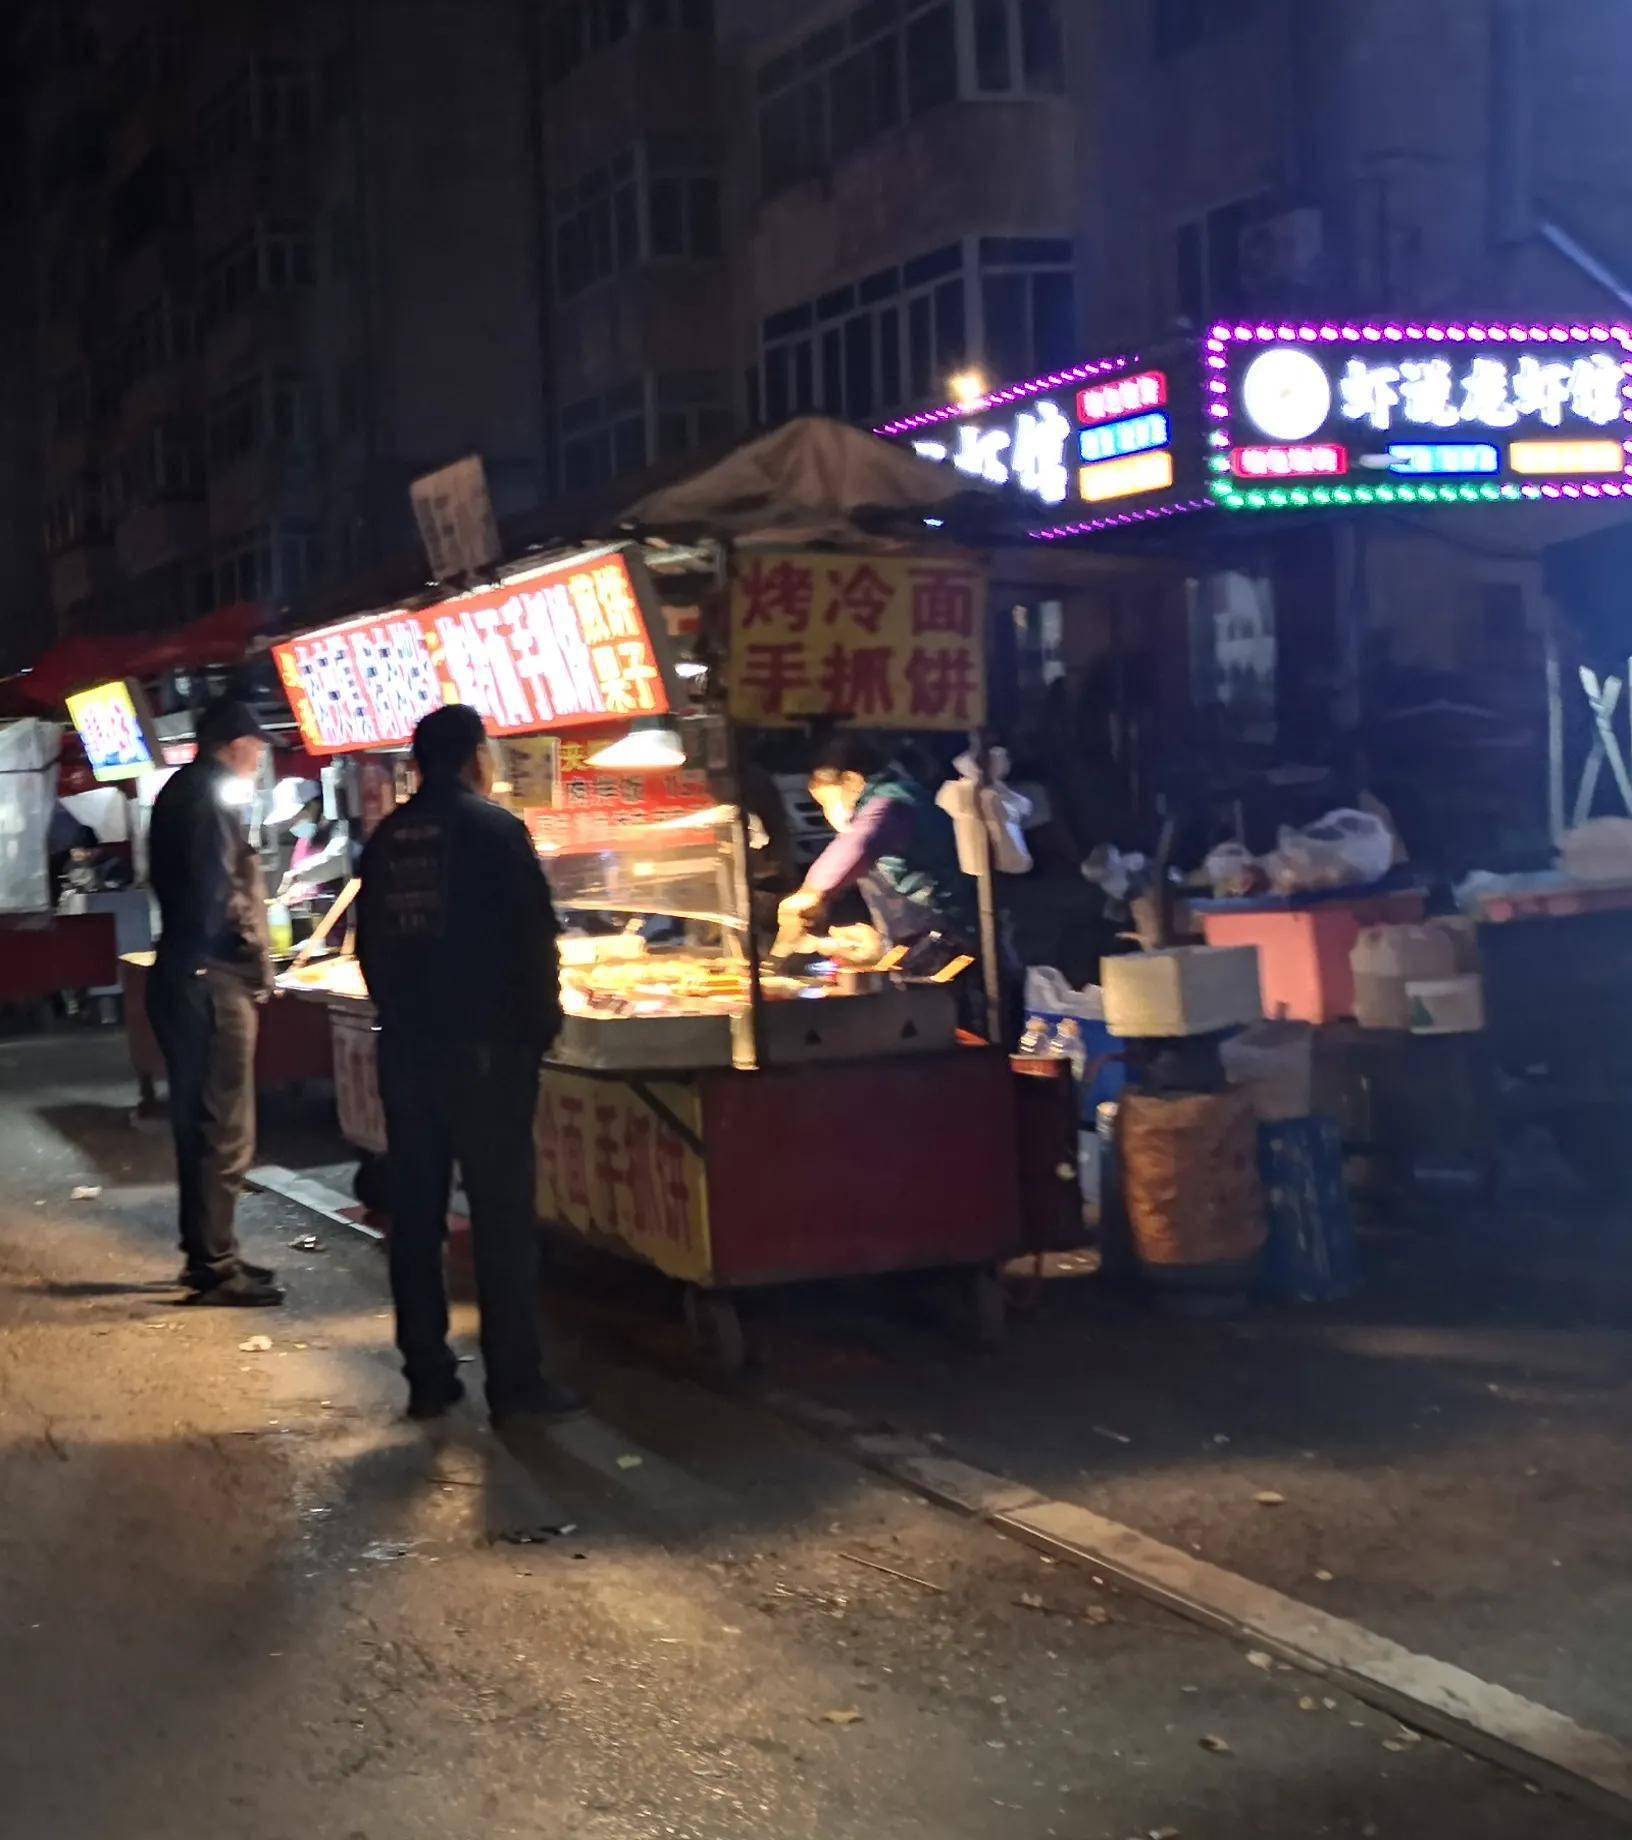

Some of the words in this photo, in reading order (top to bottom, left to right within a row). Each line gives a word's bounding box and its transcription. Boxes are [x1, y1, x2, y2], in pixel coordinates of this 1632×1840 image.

[741, 559, 973, 636] 烤冷面
[739, 643, 978, 719] 手抓饼
